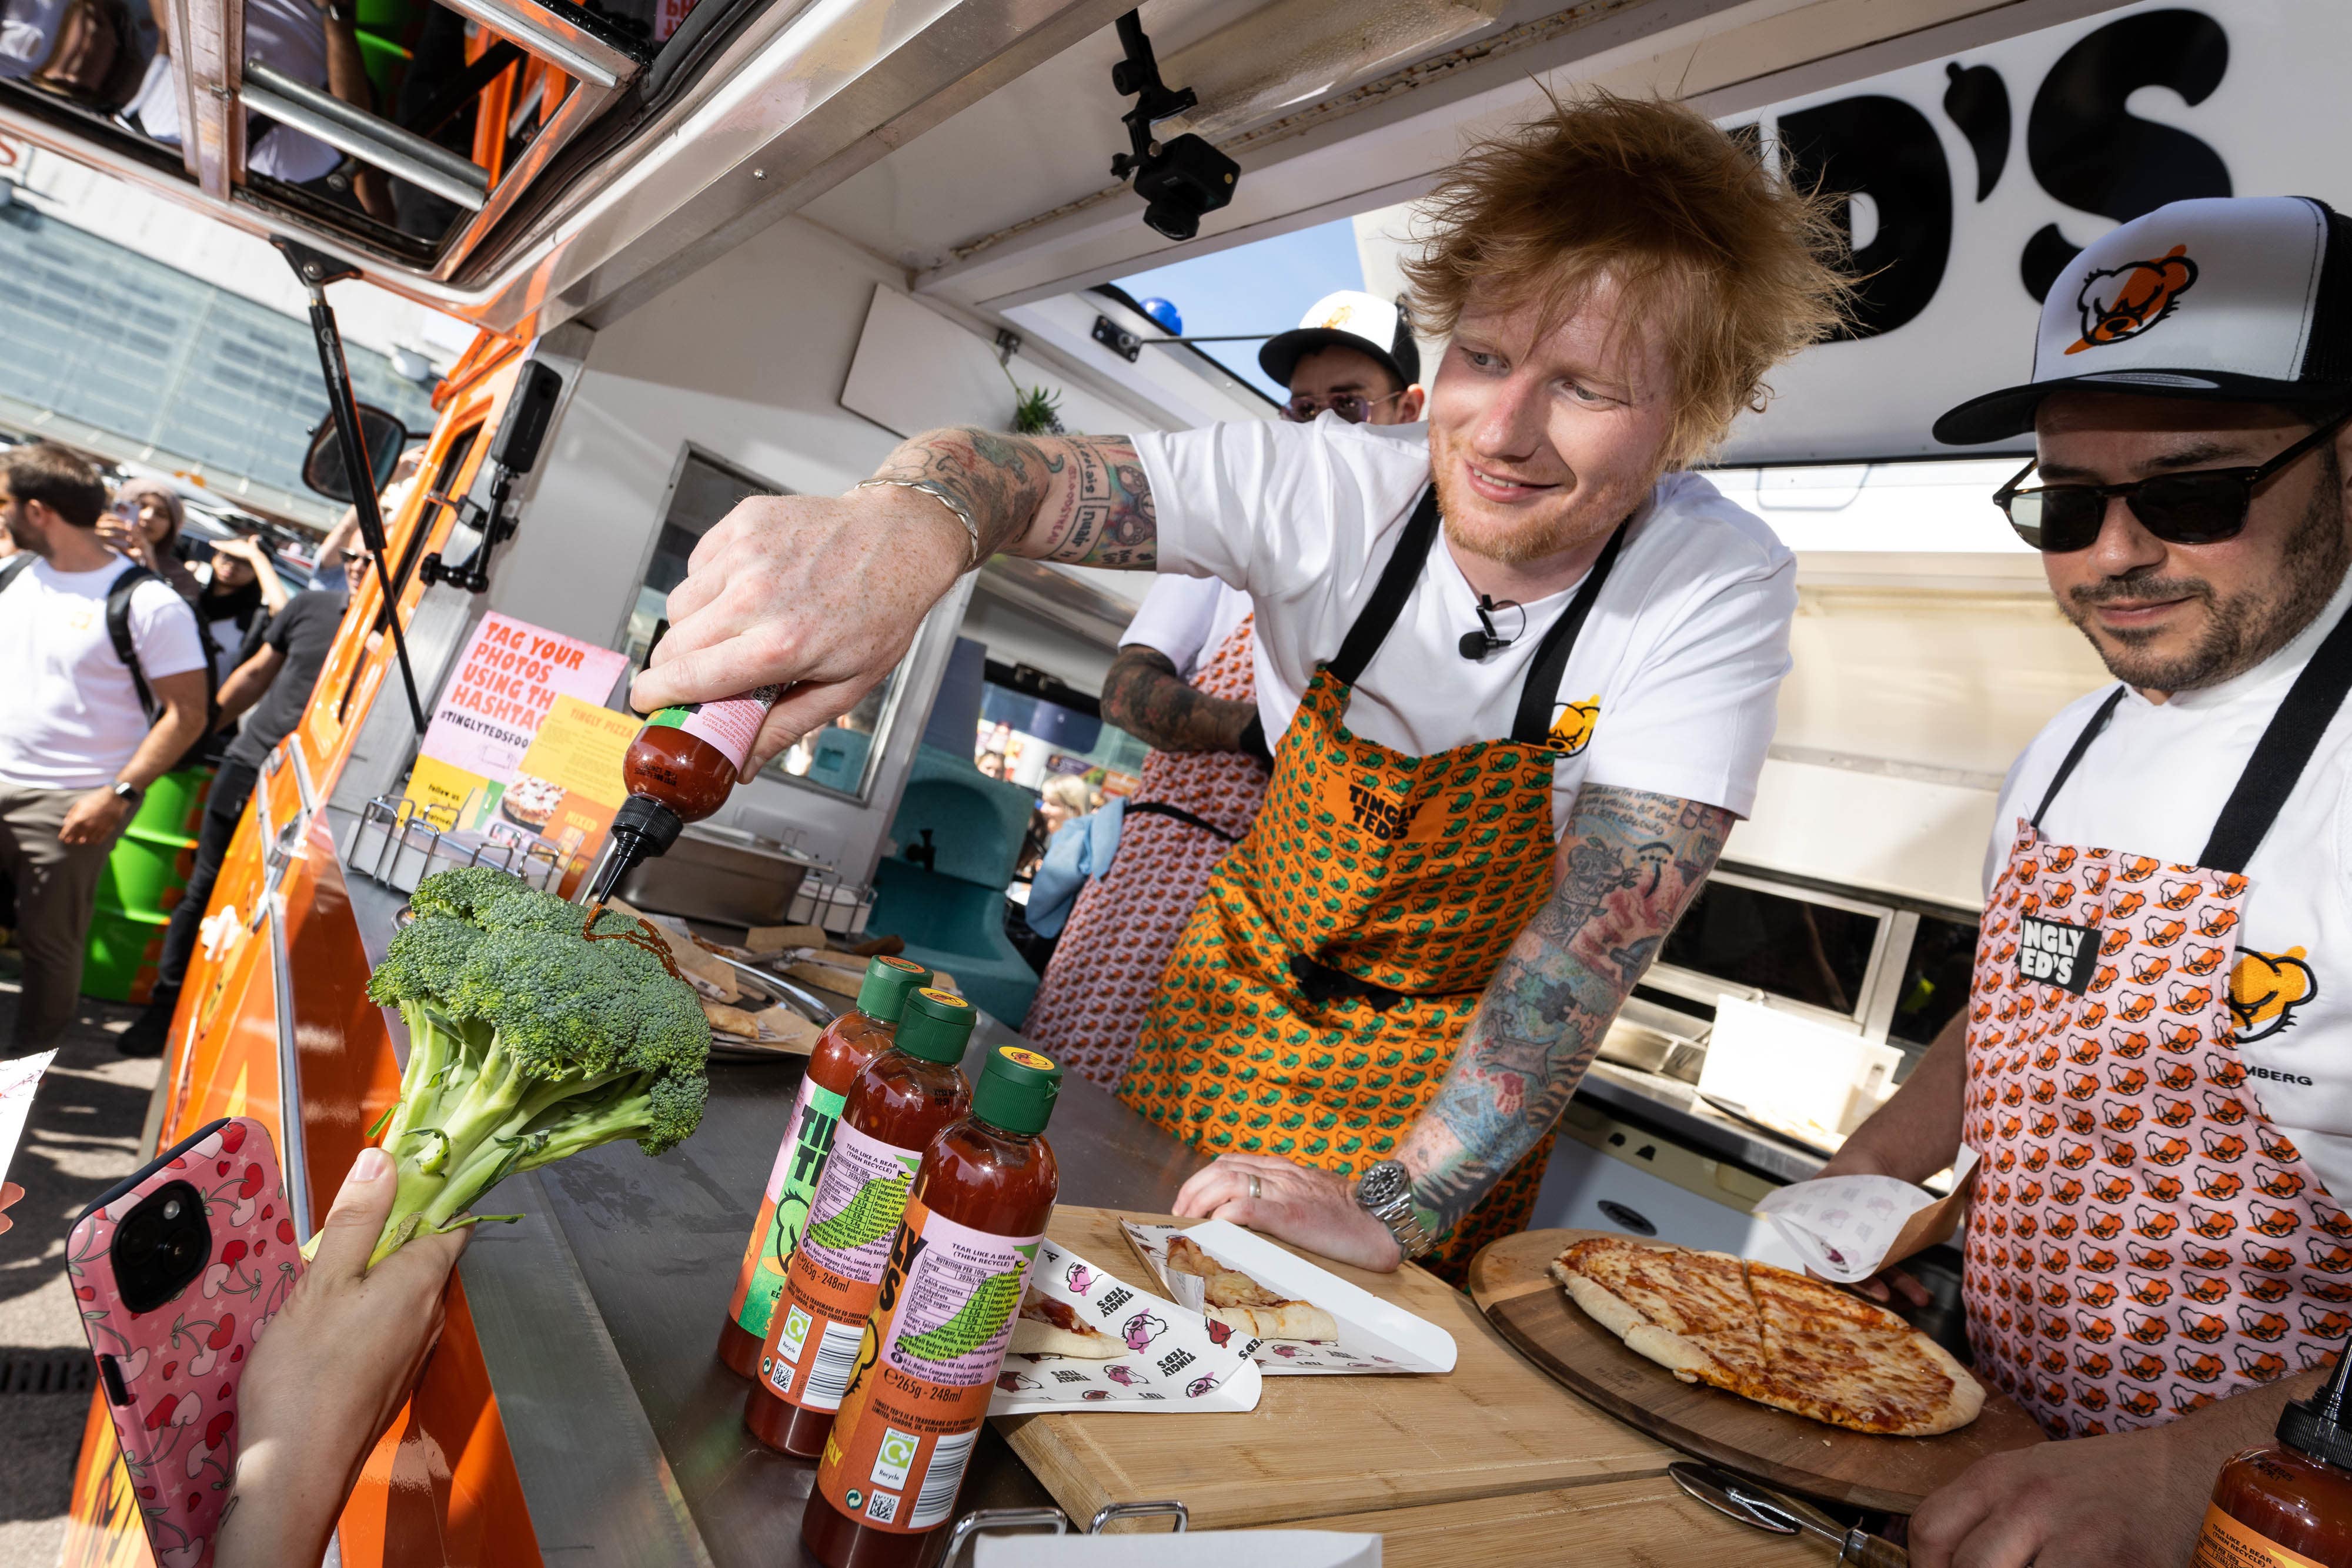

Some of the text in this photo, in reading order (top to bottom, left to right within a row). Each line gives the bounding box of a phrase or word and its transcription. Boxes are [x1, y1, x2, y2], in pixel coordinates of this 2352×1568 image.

[483, 620, 585, 672] TAG YOUR
[471, 640, 553, 684] PHOTOS
[460, 661, 524, 701] USING
[570, 707, 634, 740] TINGLY PIZZA
[1349, 784, 1425, 825] TINGLY
[1353, 804, 1410, 840] TED'S
[846, 1143, 859, 1155] TEAR
[859, 1151, 872, 1161] LIKE
[879, 1159, 898, 1169] BEAR
[846, 1150, 893, 1175] (THEN RECYCLE)
[836, 1154, 871, 1179] NUTRITION 100g
[834, 1178, 851, 1193] saturates
[847, 1171, 877, 1188] 203kJ/48kcal
[880, 1182, 907, 1194] Ingredients:
[876, 1194, 891, 1204] Water,
[877, 1188, 899, 1199] Jalapeno
[871, 1206, 891, 1218] Vinegar,
[874, 1200, 900, 1212] Grape Juice
[867, 1219, 884, 1229] Tomato
[870, 1212, 898, 1225] Concentrated
[830, 1223, 887, 1249] Paprika, Herb, Chilli Extract.
[844, 1224, 880, 1242] Smoked Sea Salt,
[865, 1225, 882, 1235] Lemon
[842, 1239, 873, 1255] After Opening
[951, 1243, 971, 1253] TEAR
[973, 1249, 989, 1258] LIKE
[821, 1253, 862, 1275] Company (Ireland)
[824, 1245, 873, 1269] Foods London,
[923, 1258, 940, 1272] Energy
[953, 1251, 1010, 1268] (THEN RECYCLE)
[800, 1258, 851, 1293] 265g 248ml
[823, 1261, 870, 1283] Blackrock, Dublin
[920, 1266, 929, 1275] Fat
[935, 1256, 962, 1271] NUTRITION
[973, 1268, 987, 1278] 100g
[915, 1282, 948, 1301] Carbohydrate
[924, 1276, 964, 1296] which saturates
[808, 1296, 835, 1313] TRADEMARK
[910, 1297, 928, 1310] Protein
[918, 1292, 951, 1312] which sugars
[1095, 1286, 1127, 1309] TED'S
[1102, 1289, 1135, 1318] TINGLY
[794, 1293, 809, 1309] LONDON,
[816, 1308, 827, 1317] USED
[827, 1312, 843, 1322] UNDER
[843, 1316, 863, 1326] LICENSE.
[907, 1305, 917, 1314] Salt
[903, 1319, 958, 1346] Starch, Smoked Paprika,
[904, 1312, 976, 1339] Ginger, Spirit Vinegar, Smoked
[781, 1340, 797, 1355] Recycle
[908, 1339, 925, 1351] Before
[926, 1339, 943, 1350] Before
[916, 1352, 947, 1367] Heinz Foods
[1156, 1347, 1187, 1370] TED'S
[1162, 1351, 1197, 1378] TINGLY
[913, 1361, 974, 1380] Heinz Company (Ireland)
[915, 1371, 958, 1386] Court, Blackrock,
[1050, 1369, 1081, 1378] TED'S
[1058, 1373, 1092, 1383] TINGLY
[896, 1375, 963, 1402] 265g 248ml
[874, 1399, 890, 1412] TINGLY
[891, 1415, 937, 1433] LONDON, USED
[914, 1415, 946, 1427] TRADEMARK
[878, 1468, 900, 1482] Recycle
[2212, 1523, 2226, 1537] TEAR
[2226, 1533, 2241, 1544] LIKE
[2249, 1547, 2273, 1564] BEAR
[2212, 1532, 2266, 1568] (THEN RECYCLE)
[2218, 1547, 2227, 1556] PER
[2226, 1553, 2239, 1565] 100g
